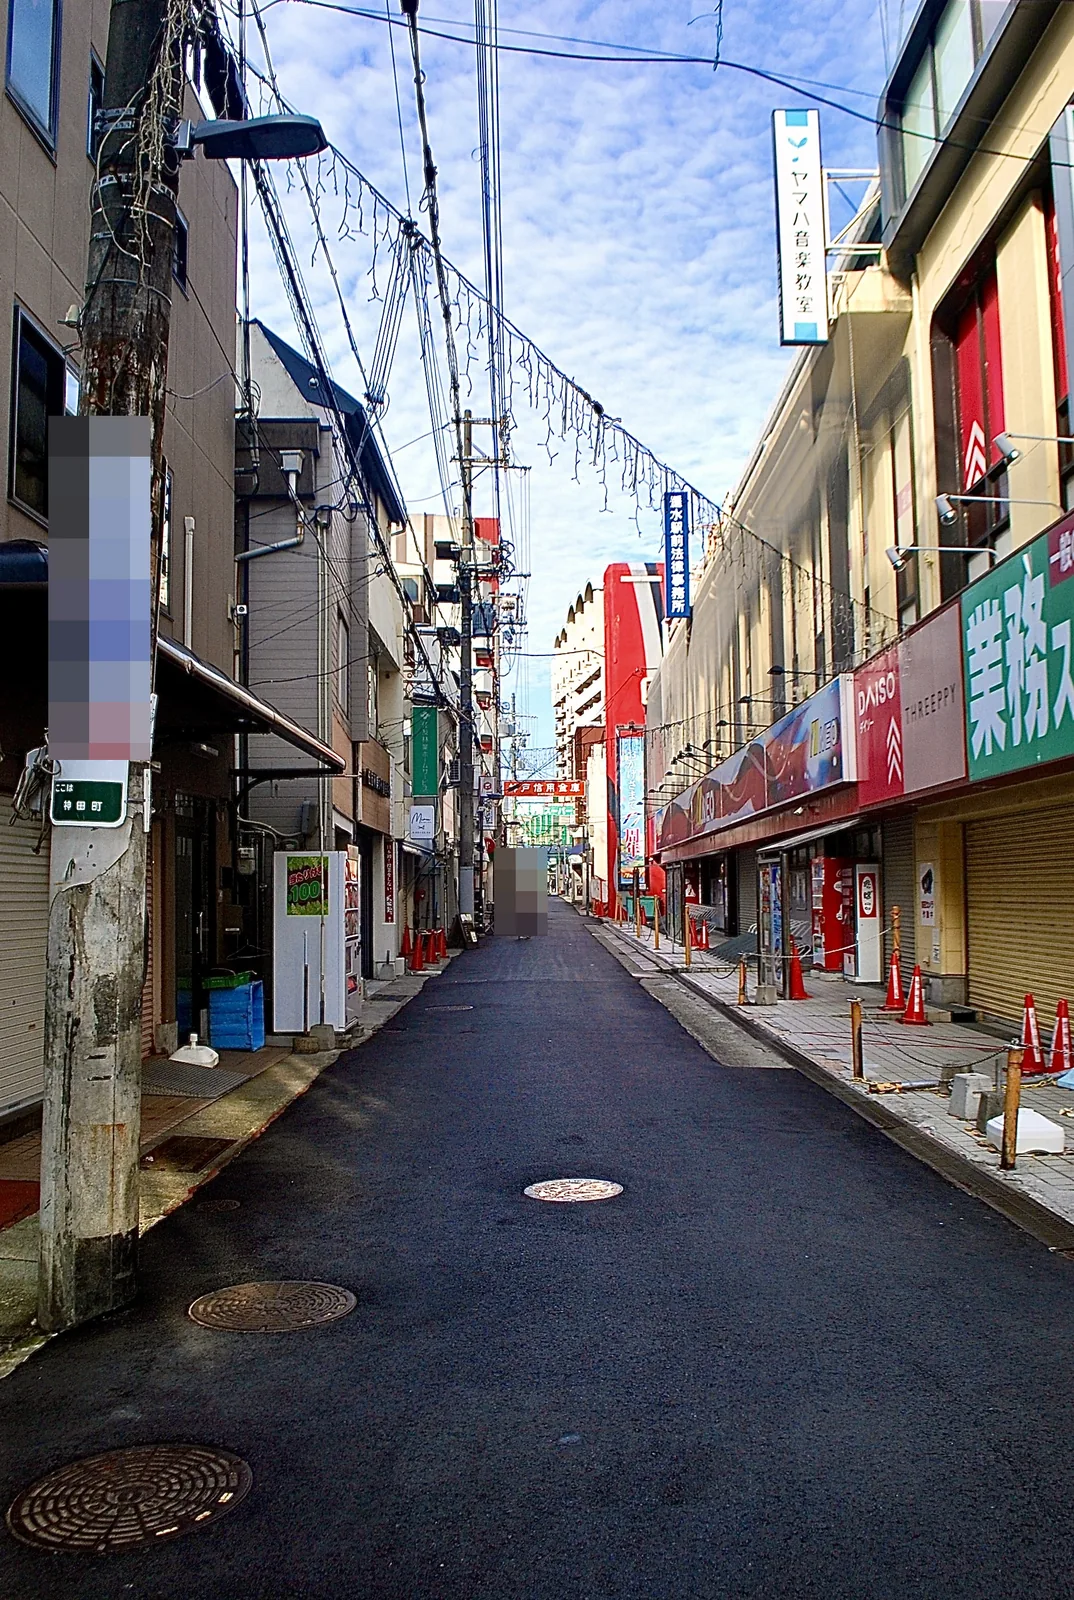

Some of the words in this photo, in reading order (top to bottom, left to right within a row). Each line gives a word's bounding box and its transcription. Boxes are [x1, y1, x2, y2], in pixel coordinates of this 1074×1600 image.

[791, 171, 813, 313] ヤマハ音楽教室
[857, 672, 896, 717] DAISO
[904, 683, 956, 725] THREEPPY
[55, 783, 74, 793] ここは
[63, 800, 103, 813] 神田町
